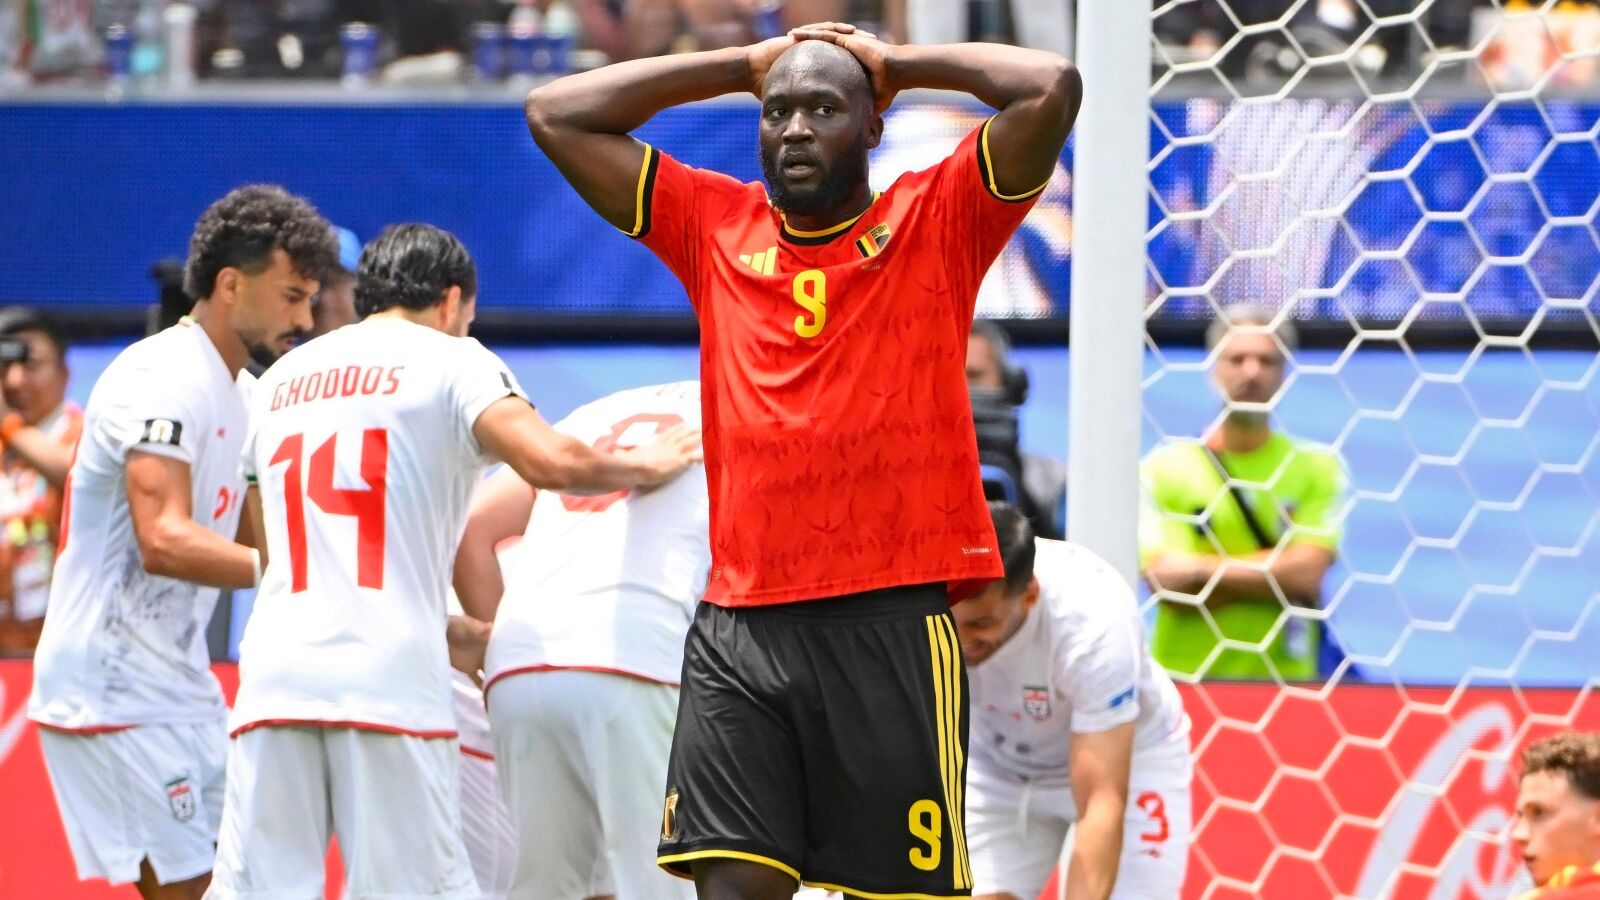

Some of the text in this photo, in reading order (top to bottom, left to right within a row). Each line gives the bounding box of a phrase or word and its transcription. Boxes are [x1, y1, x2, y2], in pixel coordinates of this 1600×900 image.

[793, 269, 827, 338] 9
[270, 366, 405, 412] GHODDOS
[268, 428, 388, 594] 14
[908, 799, 942, 871] 9
[1136, 791, 1169, 843] 3
